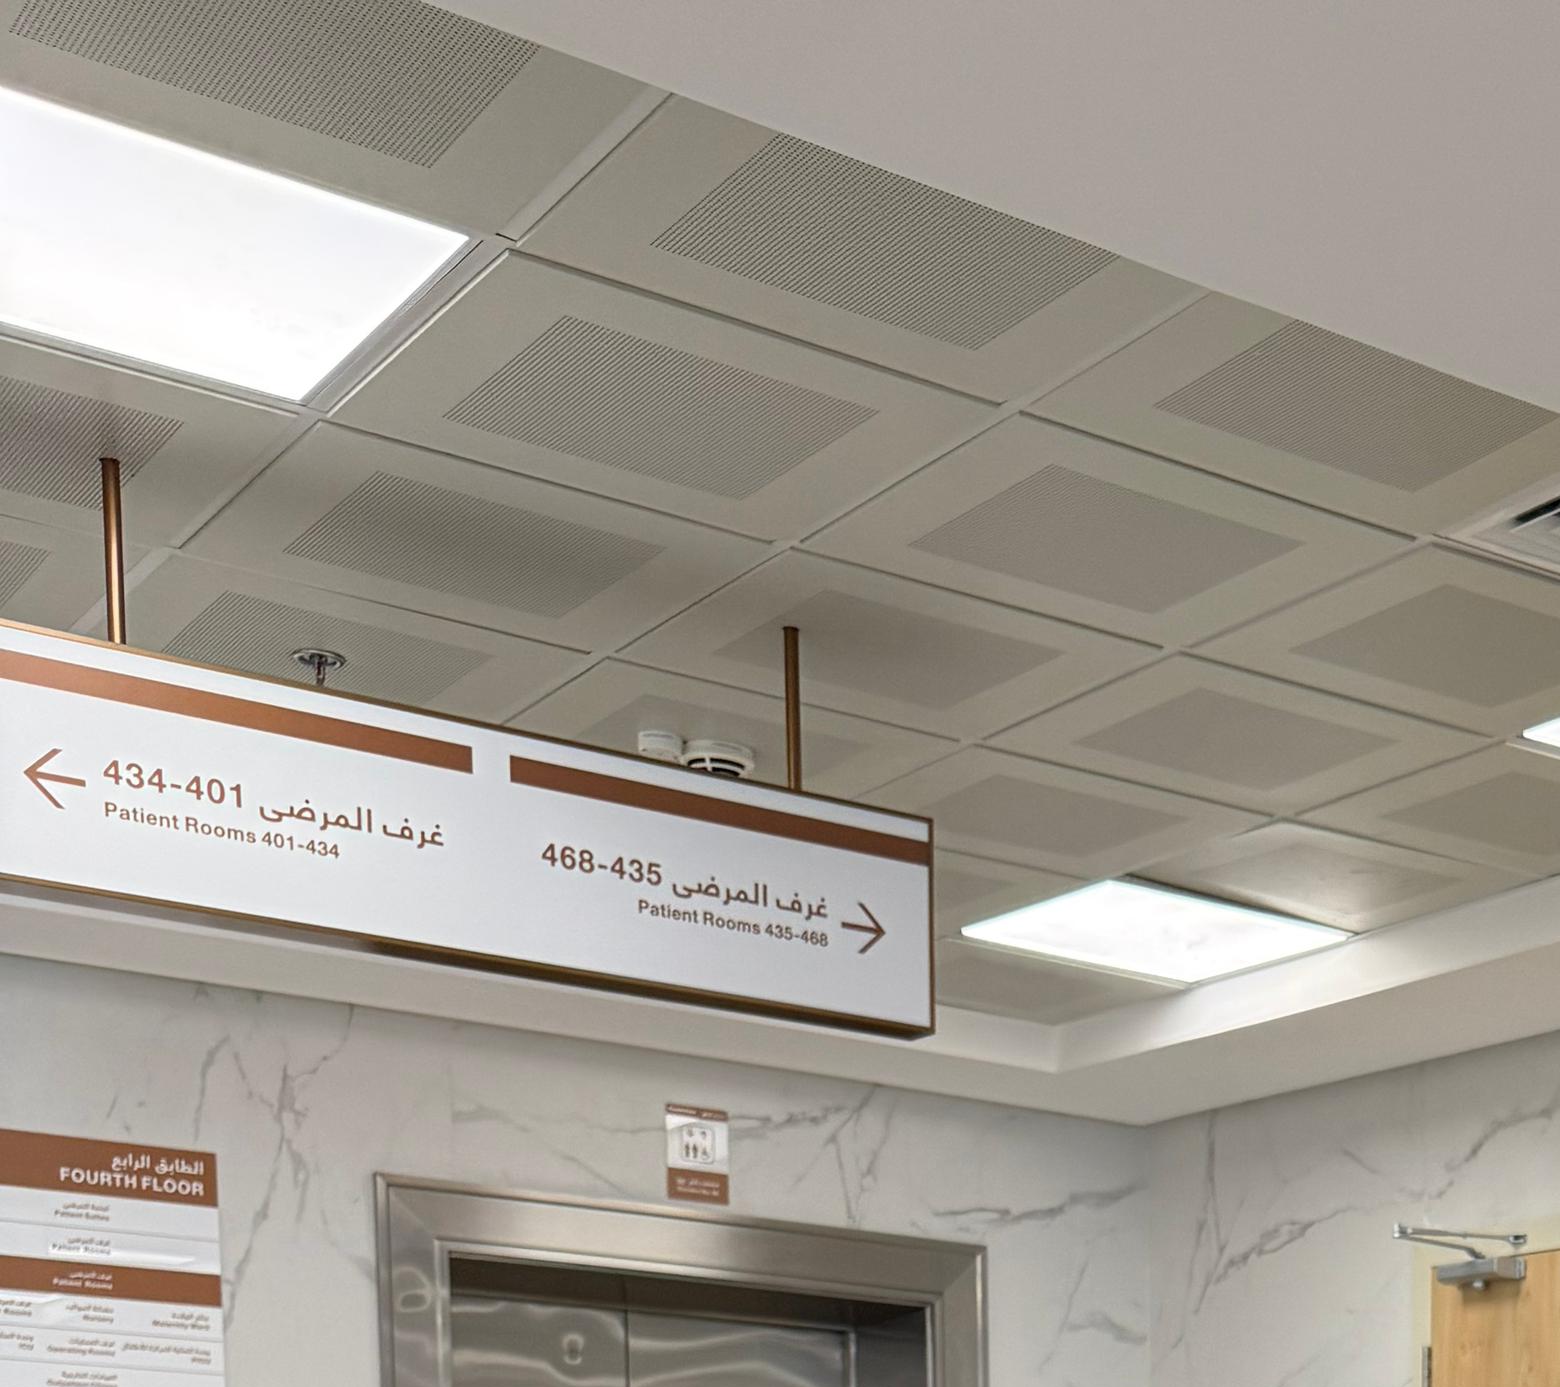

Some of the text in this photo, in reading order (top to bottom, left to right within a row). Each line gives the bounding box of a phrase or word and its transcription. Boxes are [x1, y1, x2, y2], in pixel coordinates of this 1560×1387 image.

[104, 801, 340, 859] Patient Rooms 401-434
[258, 799, 372, 833] المرضى
[382, 817, 445, 849] غرف
[672, 876, 768, 907] المرضى
[775, 892, 829, 920] غرف
[638, 900, 829, 948] Patient Rooms 435-468
[111, 1152, 204, 1175] الطابق الرابع
[59, 1167, 204, 1196] FOURTH FLOOR
